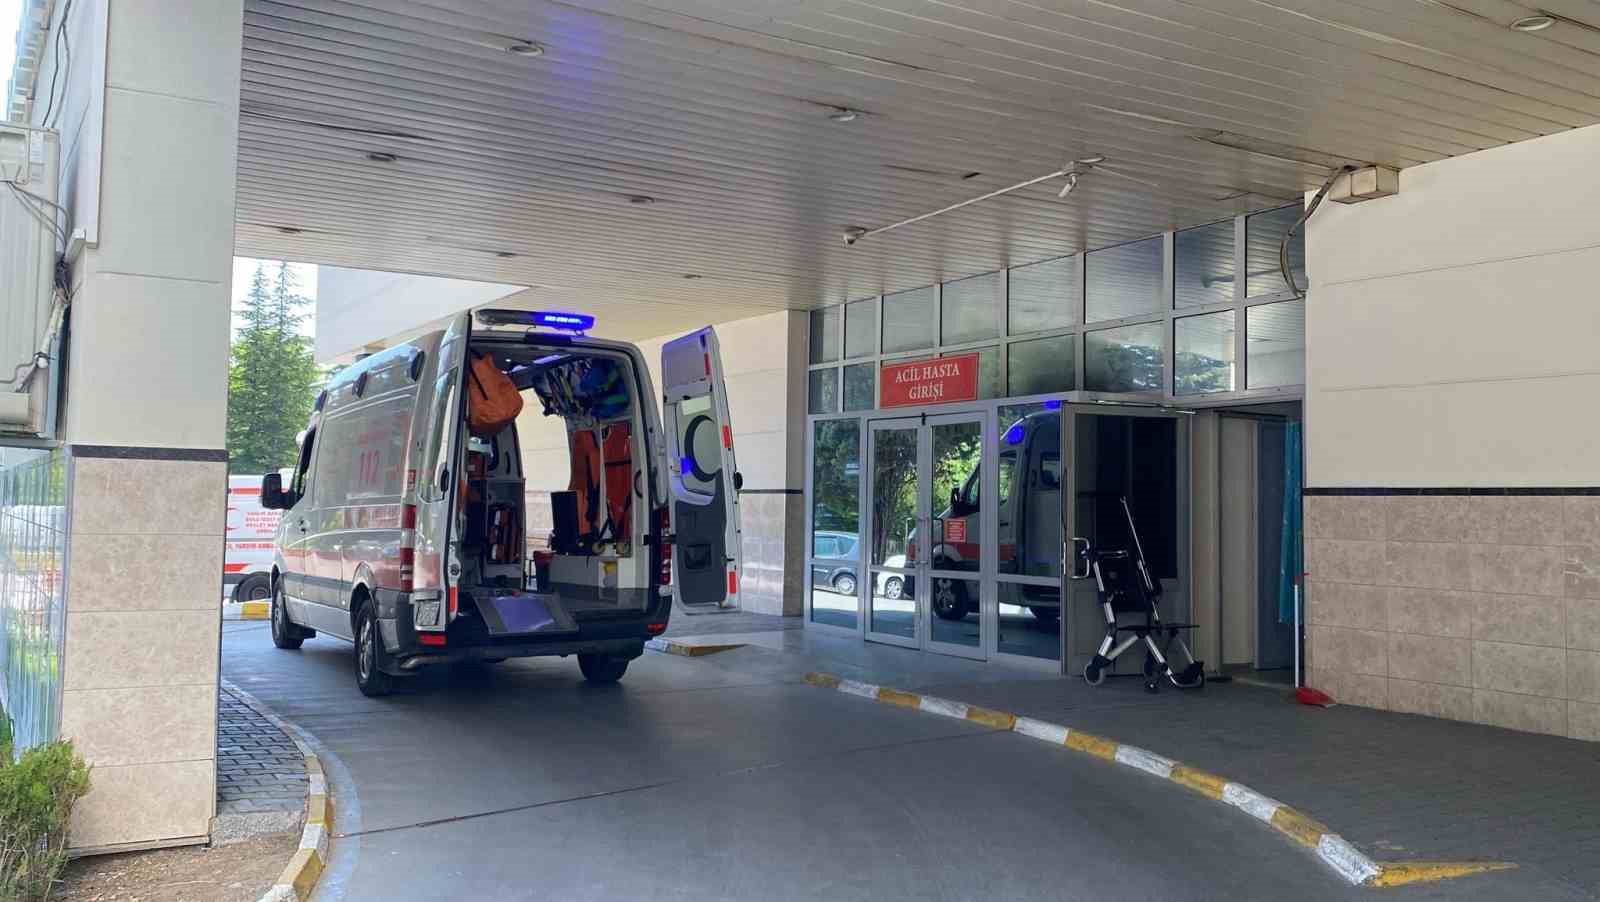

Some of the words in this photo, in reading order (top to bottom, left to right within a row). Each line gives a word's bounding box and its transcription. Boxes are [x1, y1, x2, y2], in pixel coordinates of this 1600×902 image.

[895, 366, 921, 383] ACİL
[923, 363, 960, 380] HASTA
[908, 381, 944, 400] GİRİŞİ
[360, 450, 380, 486] 112
